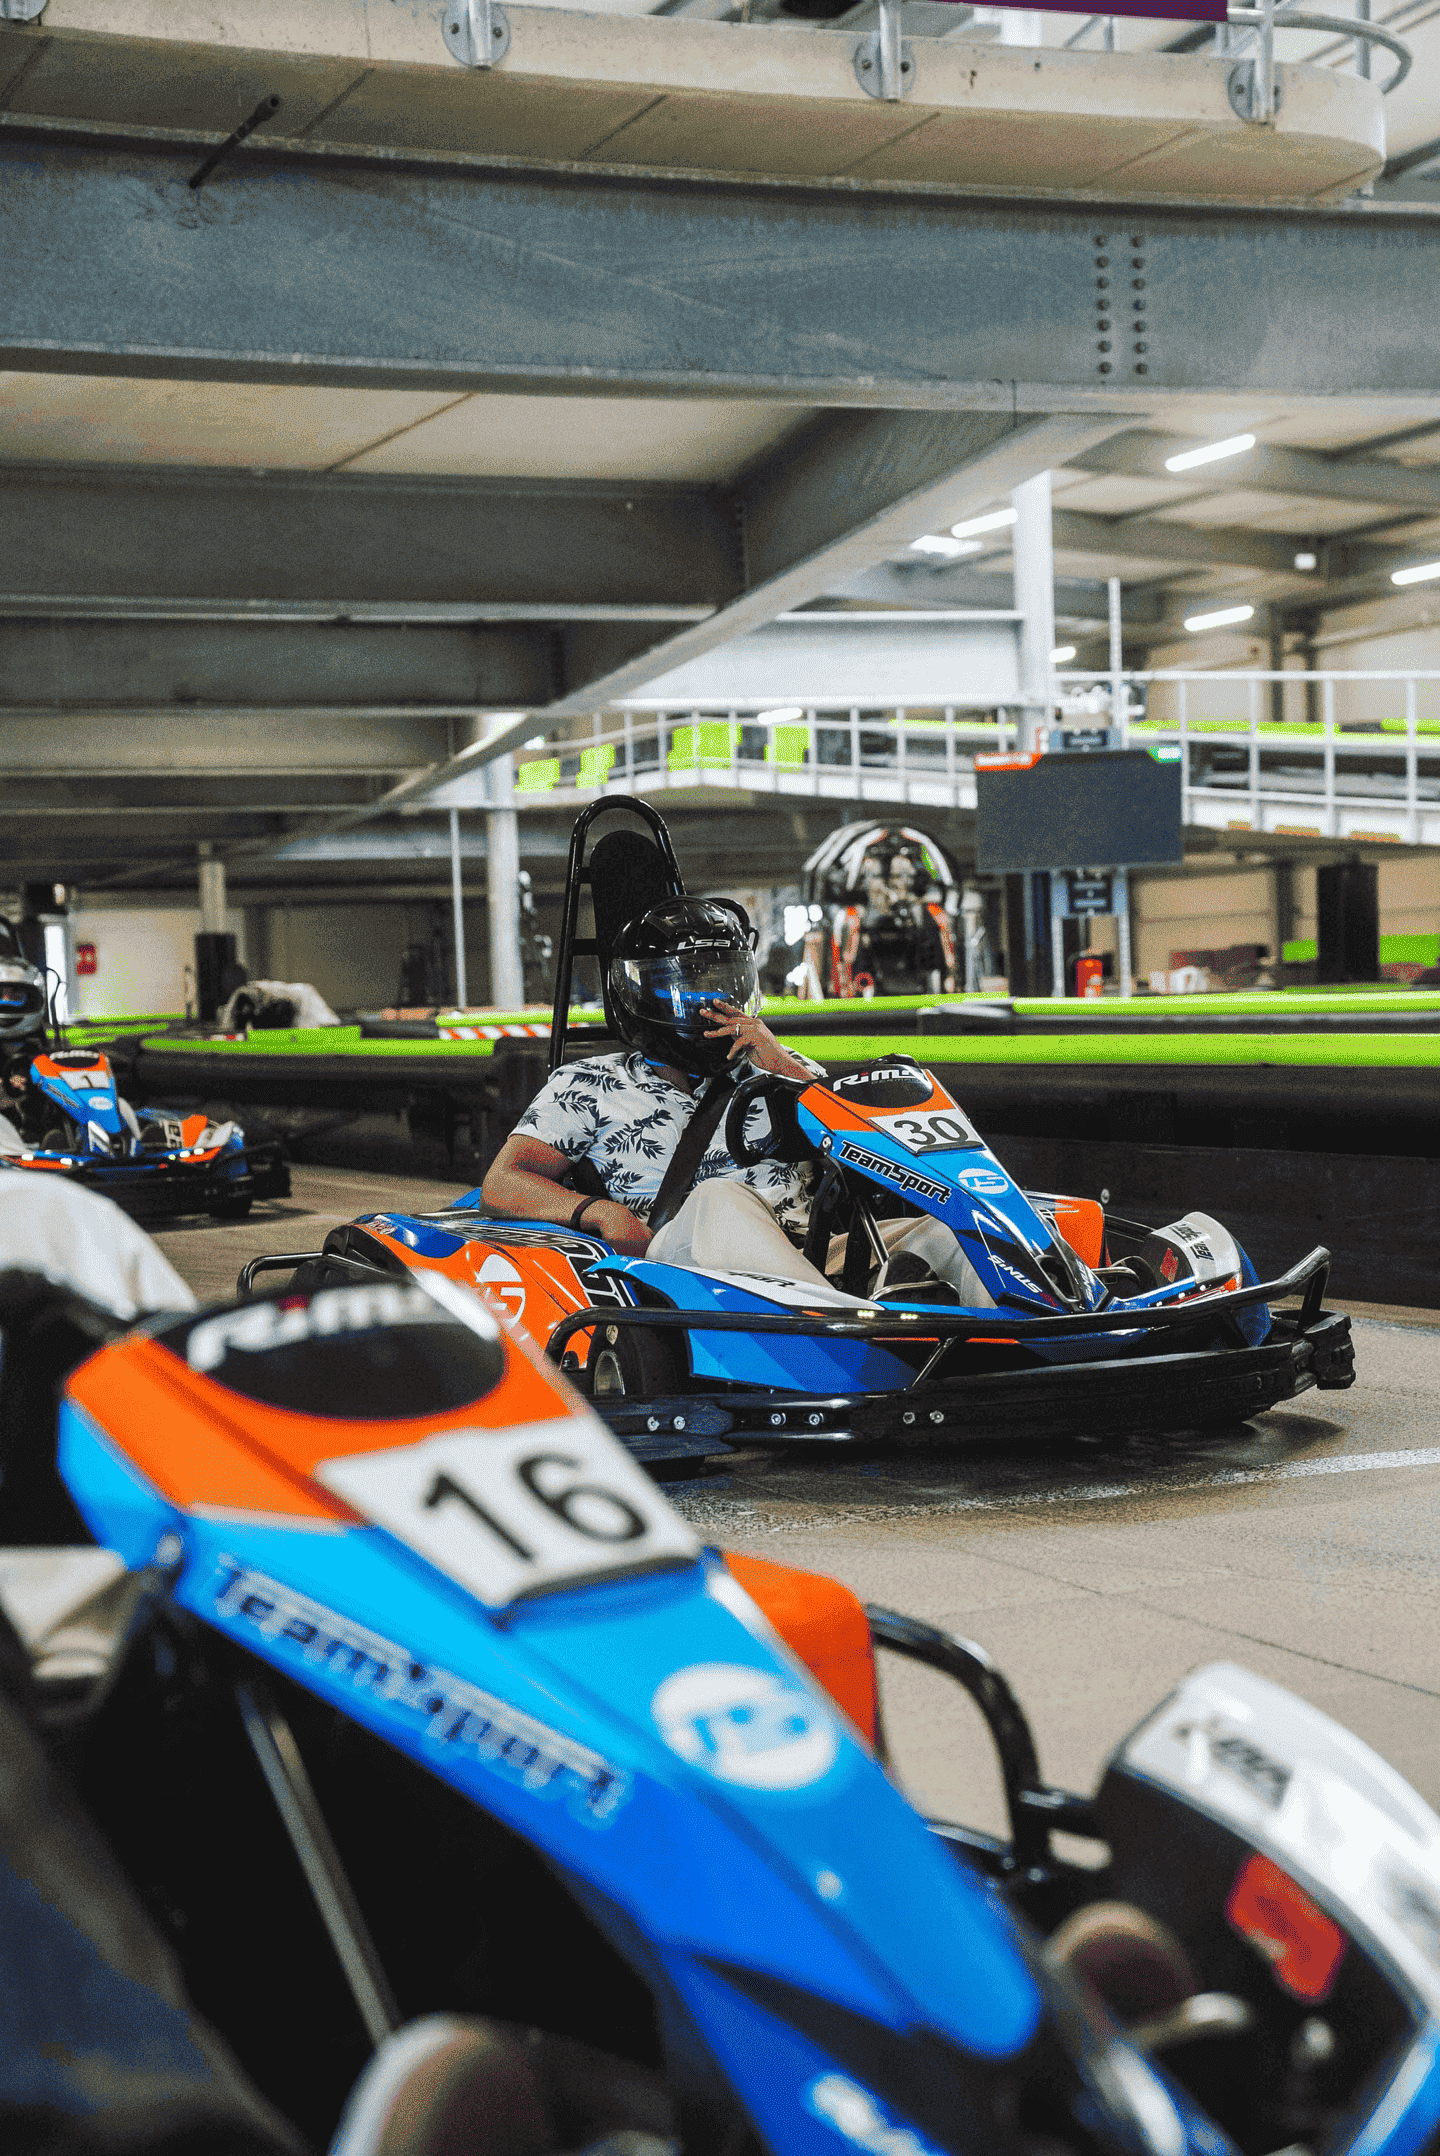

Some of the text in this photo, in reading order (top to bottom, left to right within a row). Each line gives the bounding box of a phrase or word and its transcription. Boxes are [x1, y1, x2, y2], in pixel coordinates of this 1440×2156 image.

[677, 938, 730, 951] LS2
[893, 1116, 969, 1145] 30
[839, 1140, 952, 1205] TeamSport
[423, 1451, 650, 1562] 16
